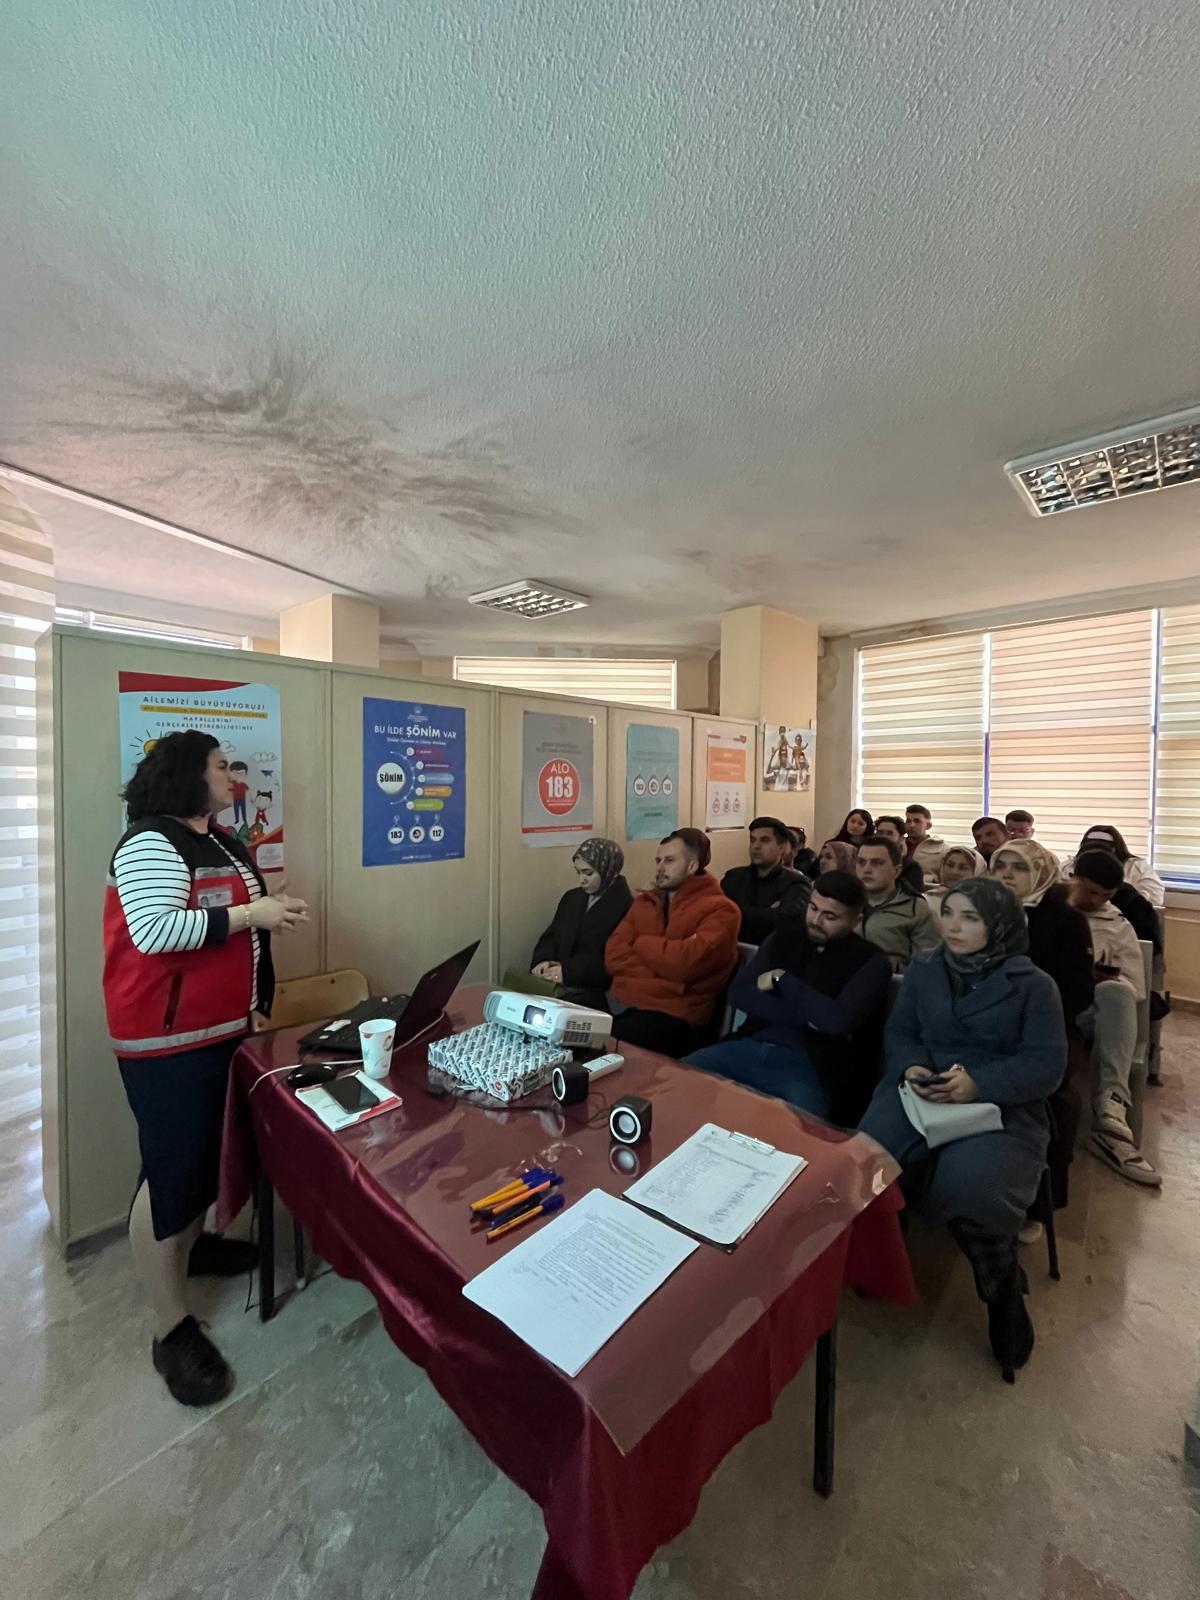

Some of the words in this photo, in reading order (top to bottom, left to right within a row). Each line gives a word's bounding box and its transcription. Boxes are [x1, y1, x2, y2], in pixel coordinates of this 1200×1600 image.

[143, 696, 189, 705] AİLEMİZİ
[374, 725, 385, 734] BU
[387, 724, 404, 735] İLDE
[406, 724, 441, 738] ŞÖNİM
[443, 731, 457, 739] VAR
[551, 762, 570, 774] ALO
[379, 772, 403, 783] ŞÖNİM
[546, 776, 573, 798] 183
[390, 830, 402, 839] 183
[432, 829, 442, 838] 112
